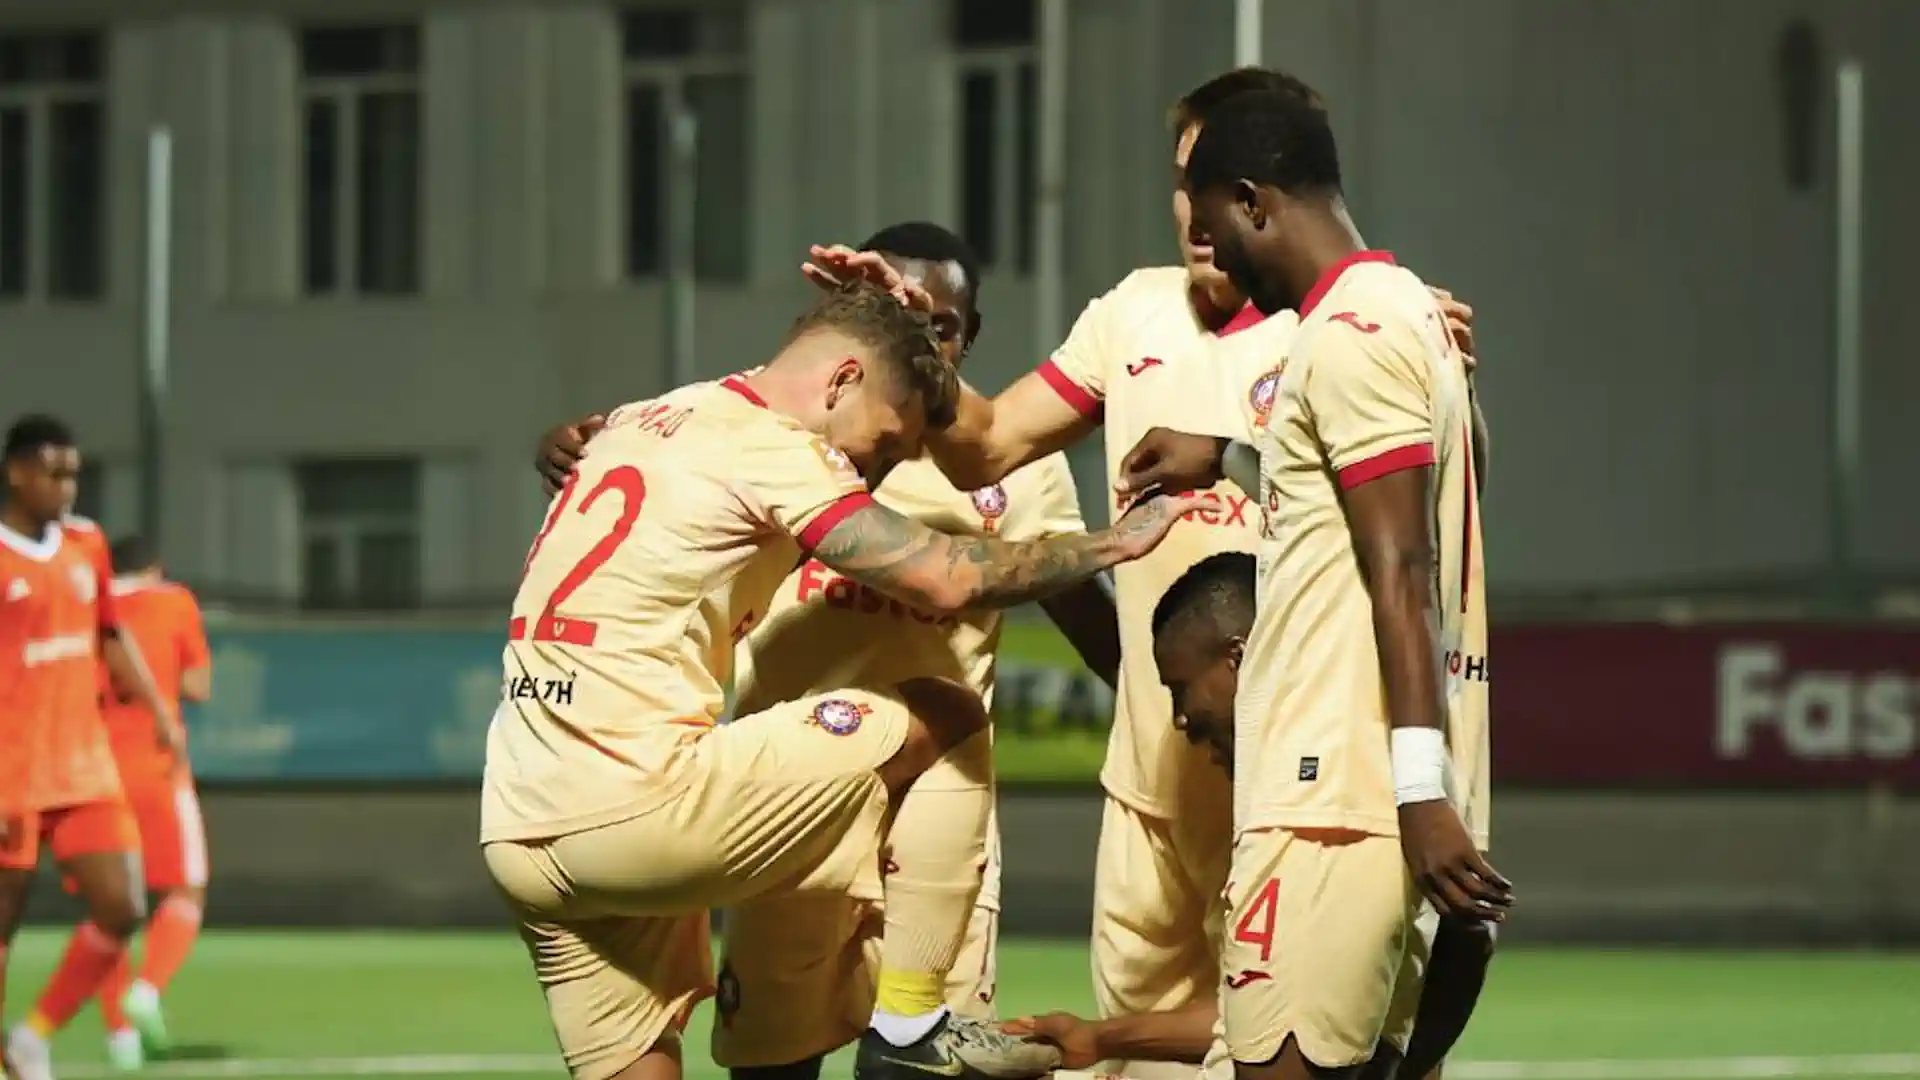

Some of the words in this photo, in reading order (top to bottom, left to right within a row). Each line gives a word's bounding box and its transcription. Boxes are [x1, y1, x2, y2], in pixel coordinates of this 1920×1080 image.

[797, 558, 958, 626] Fast
[1716, 647, 1916, 760] Fas
[1235, 878, 1280, 961] 4
